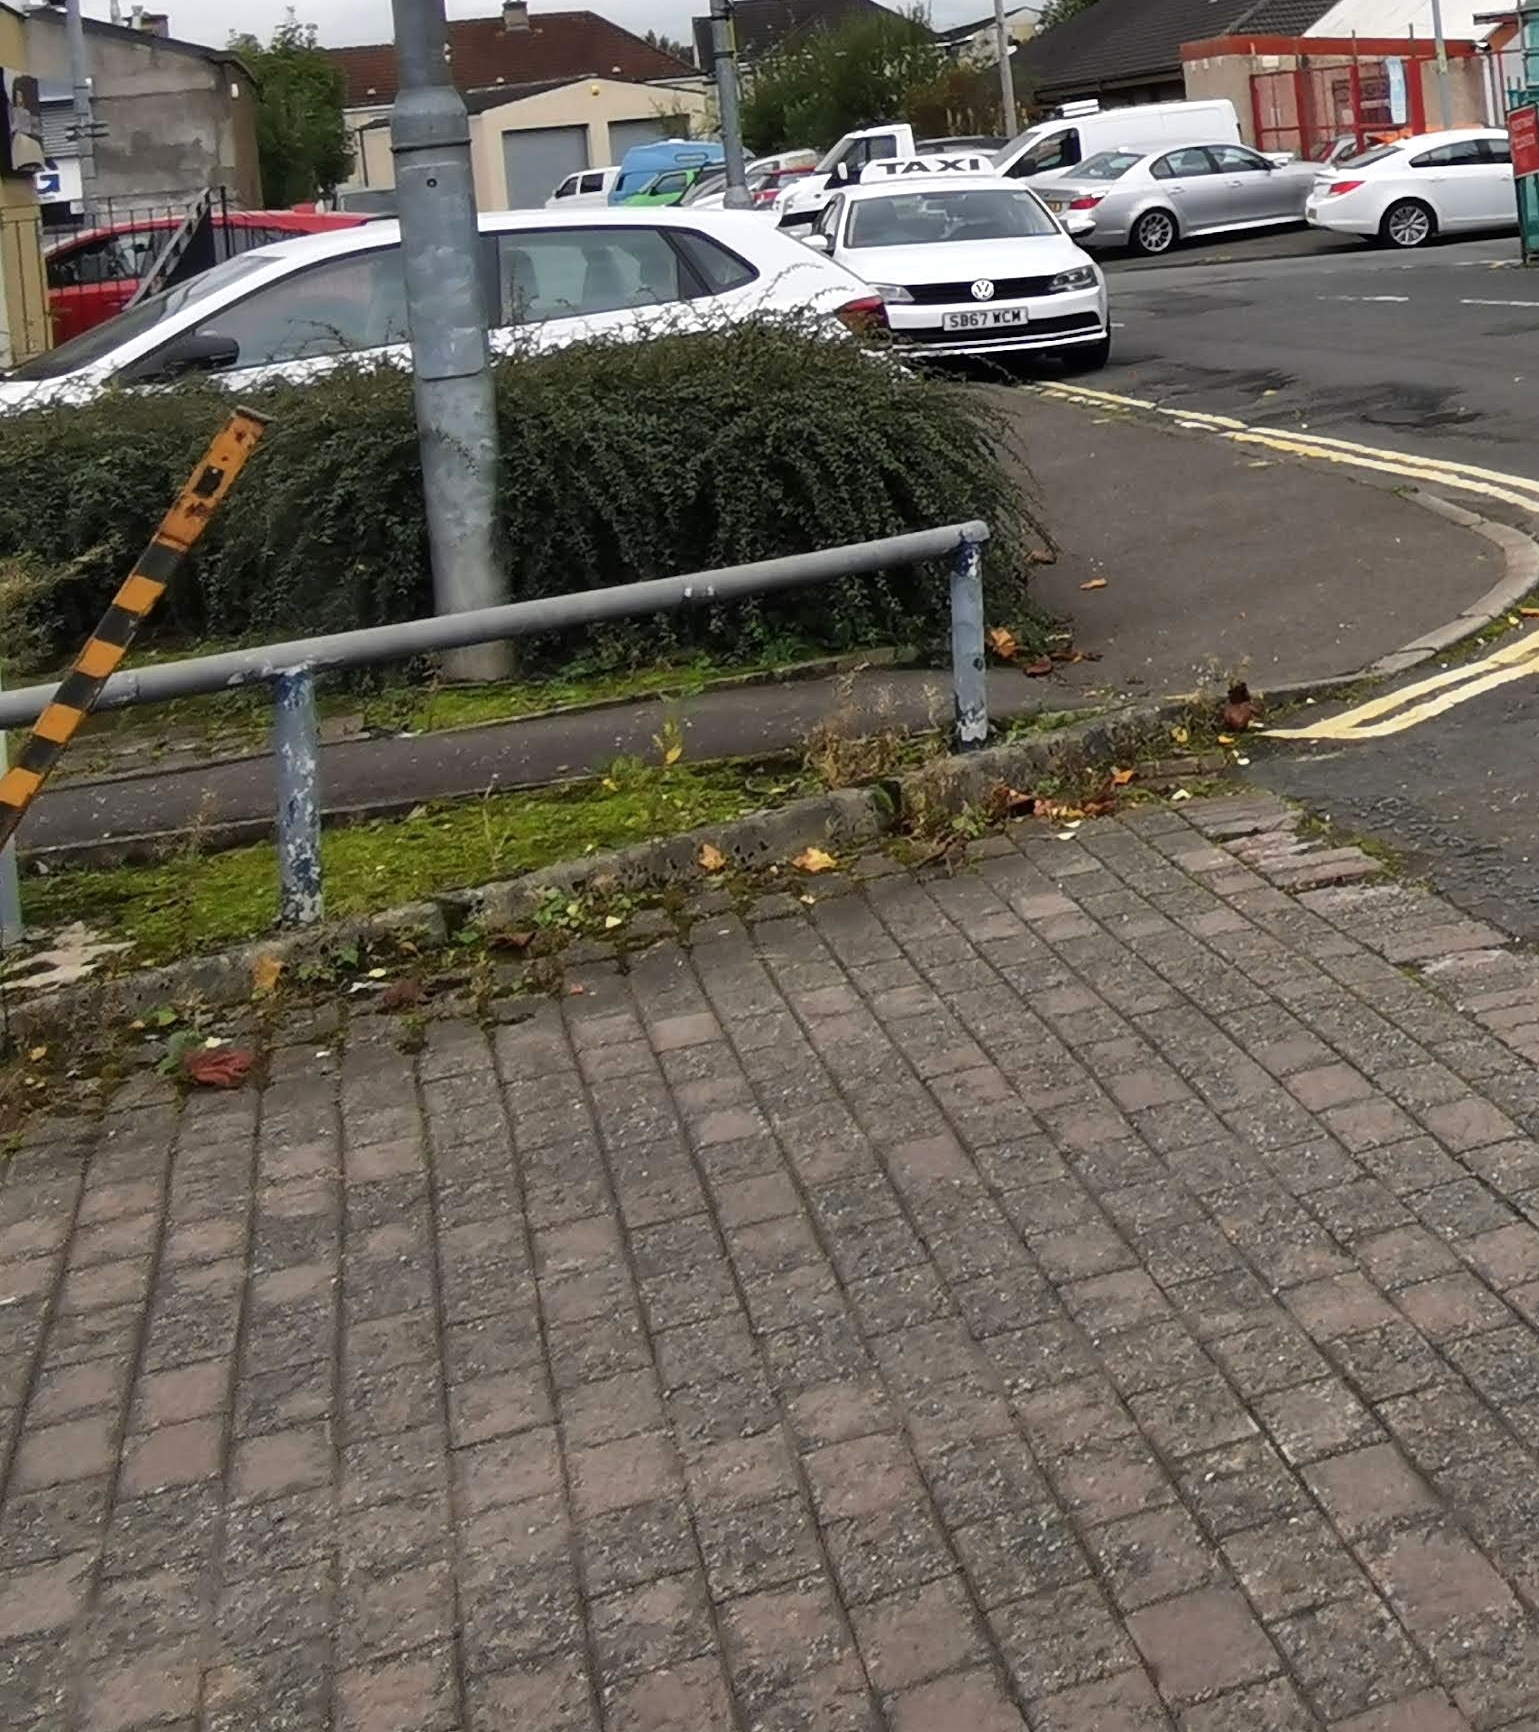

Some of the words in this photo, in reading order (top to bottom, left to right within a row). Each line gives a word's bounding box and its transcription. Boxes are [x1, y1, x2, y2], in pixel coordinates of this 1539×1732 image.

[876, 158, 981, 175] TAXI
[949, 312, 988, 328] SB67
[992, 309, 1022, 324] WCM
